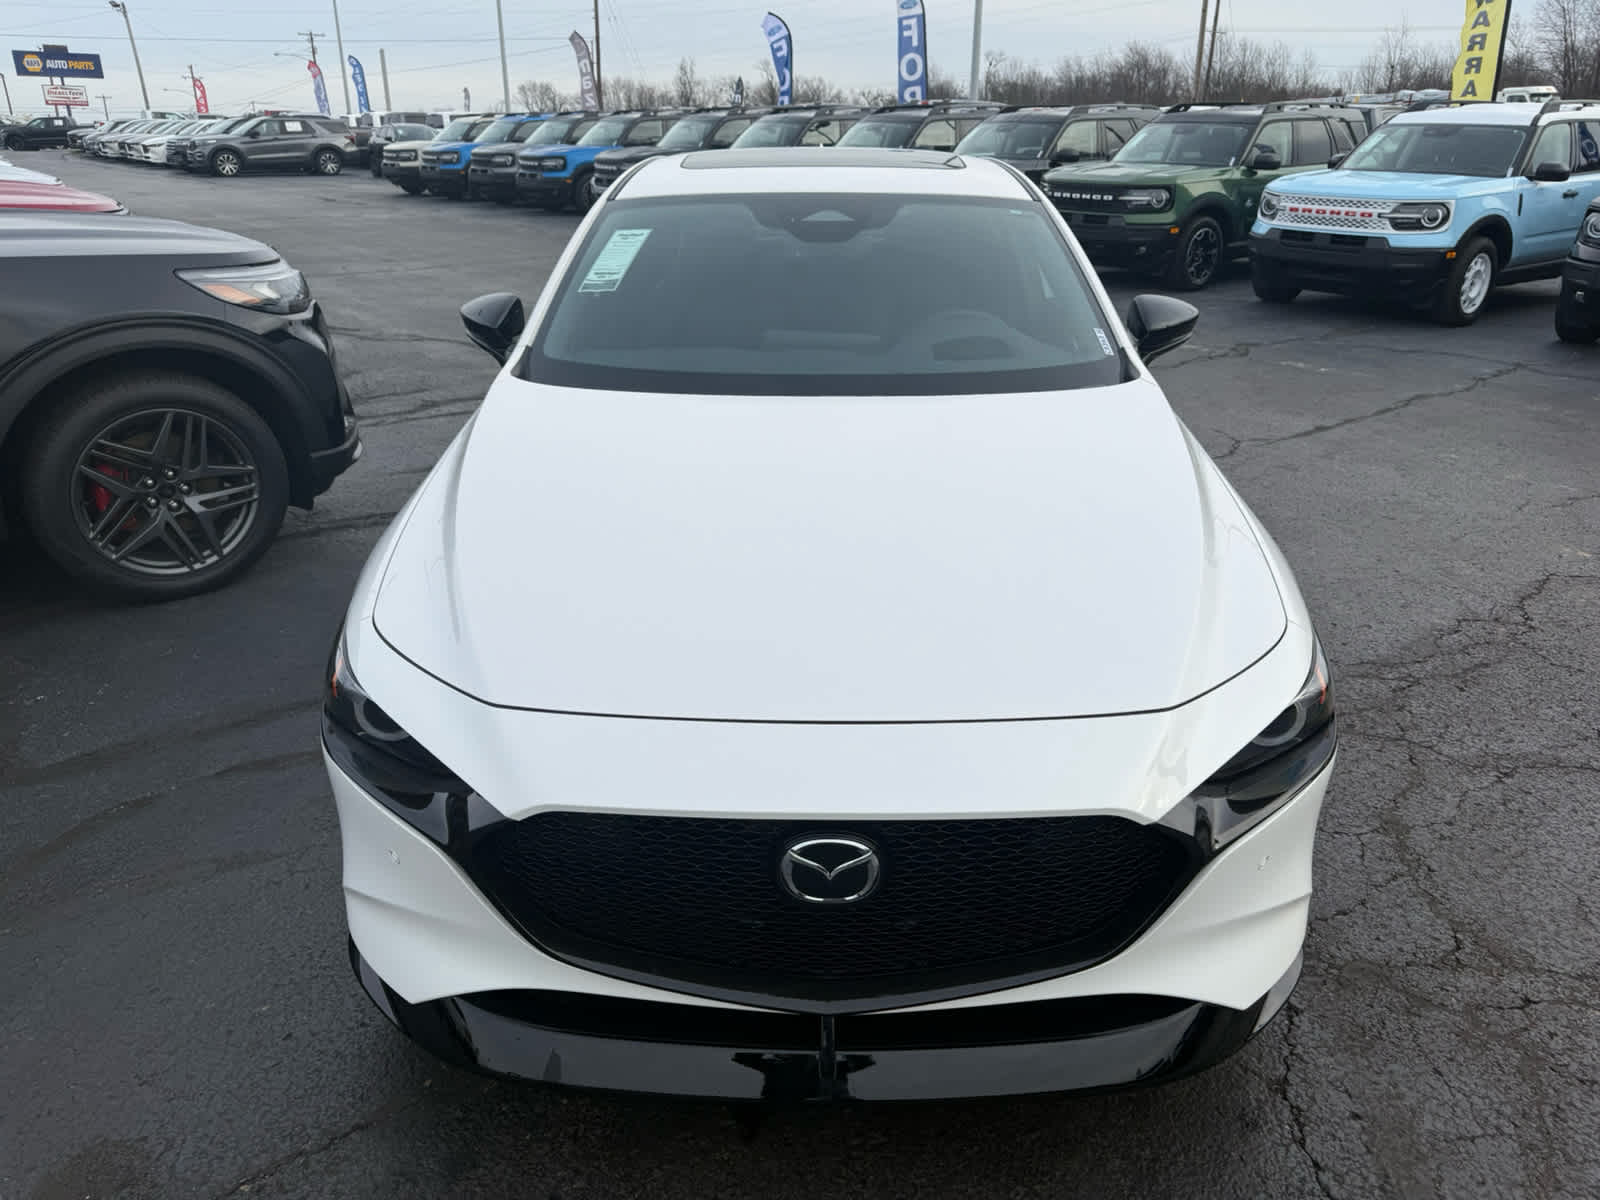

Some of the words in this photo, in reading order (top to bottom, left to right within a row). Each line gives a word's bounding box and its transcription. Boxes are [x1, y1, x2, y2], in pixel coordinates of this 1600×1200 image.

[46, 59, 68, 69] AUTO
[67, 60, 95, 70] PARTS
[1053, 191, 1113, 201] BRONCO
[1288, 207, 1373, 218] BRONCO
